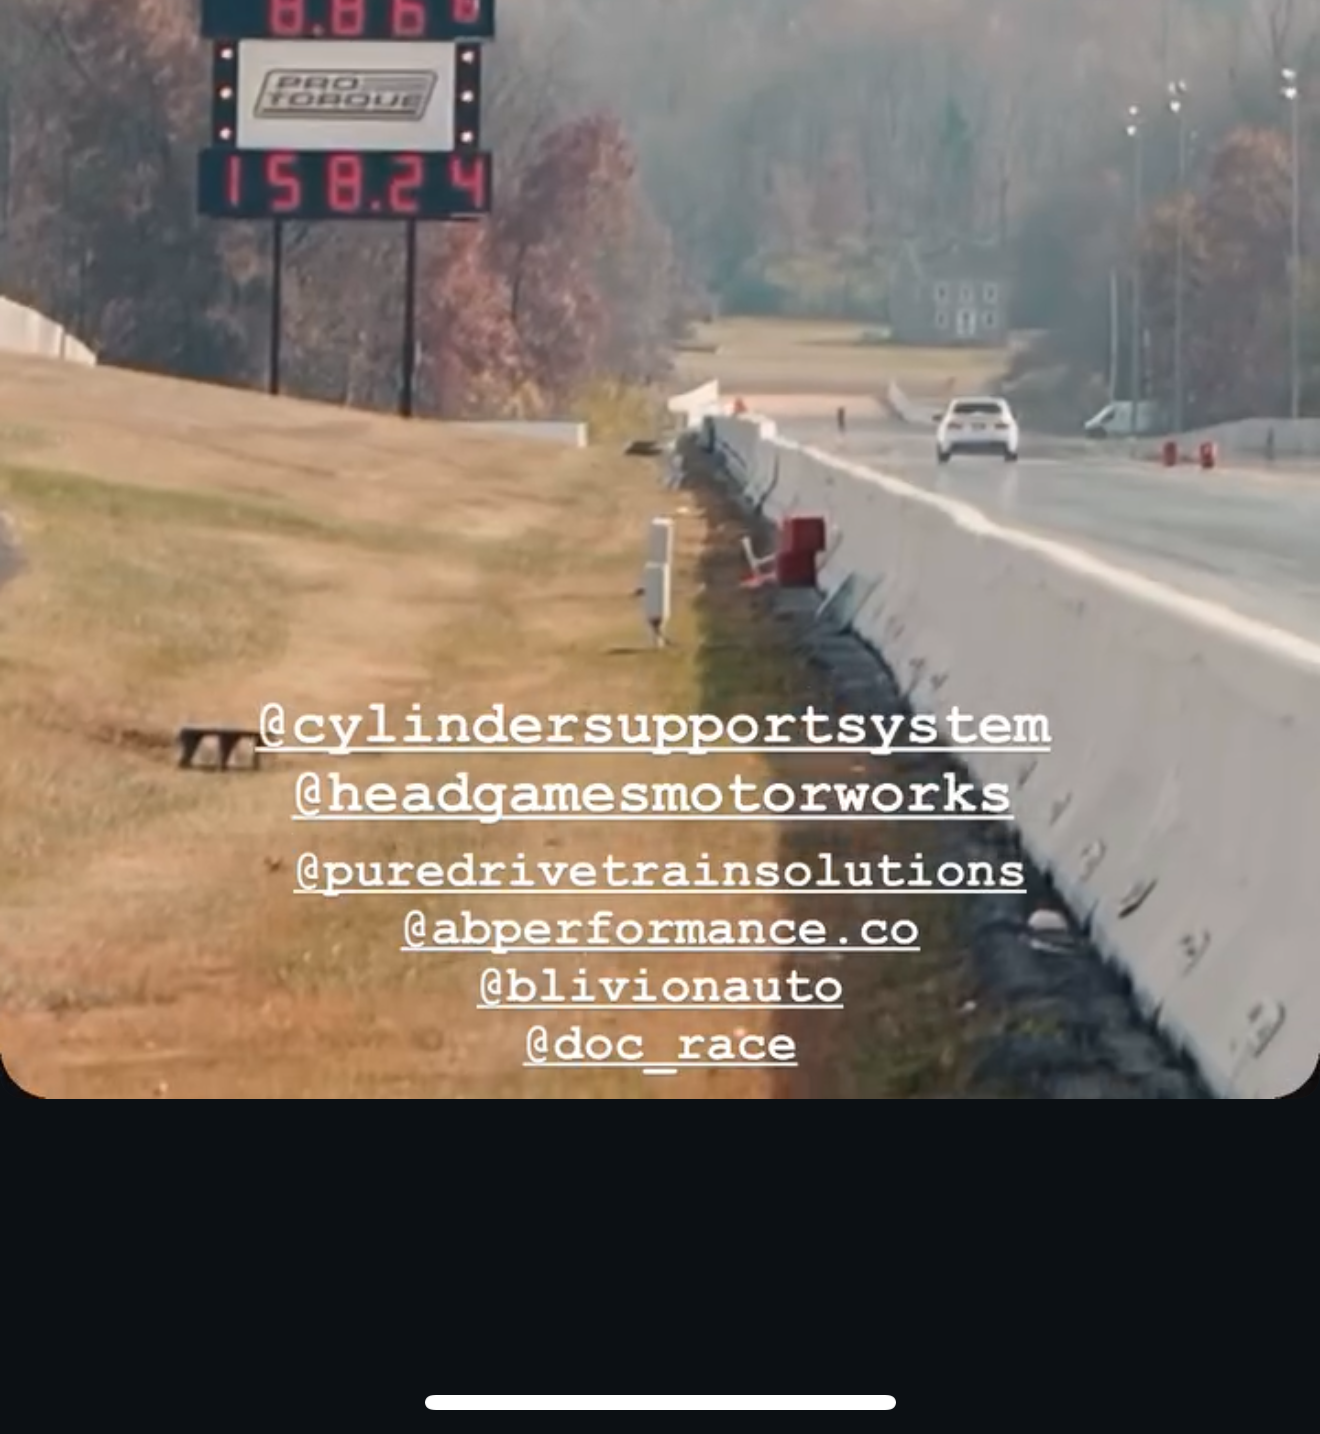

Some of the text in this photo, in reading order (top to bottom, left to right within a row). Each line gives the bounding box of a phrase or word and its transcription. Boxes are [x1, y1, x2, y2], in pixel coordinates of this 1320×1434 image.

[277, 75, 359, 90] PRO
[269, 91, 423, 107] TORQUE
[227, 153, 484, 211] 158.24
